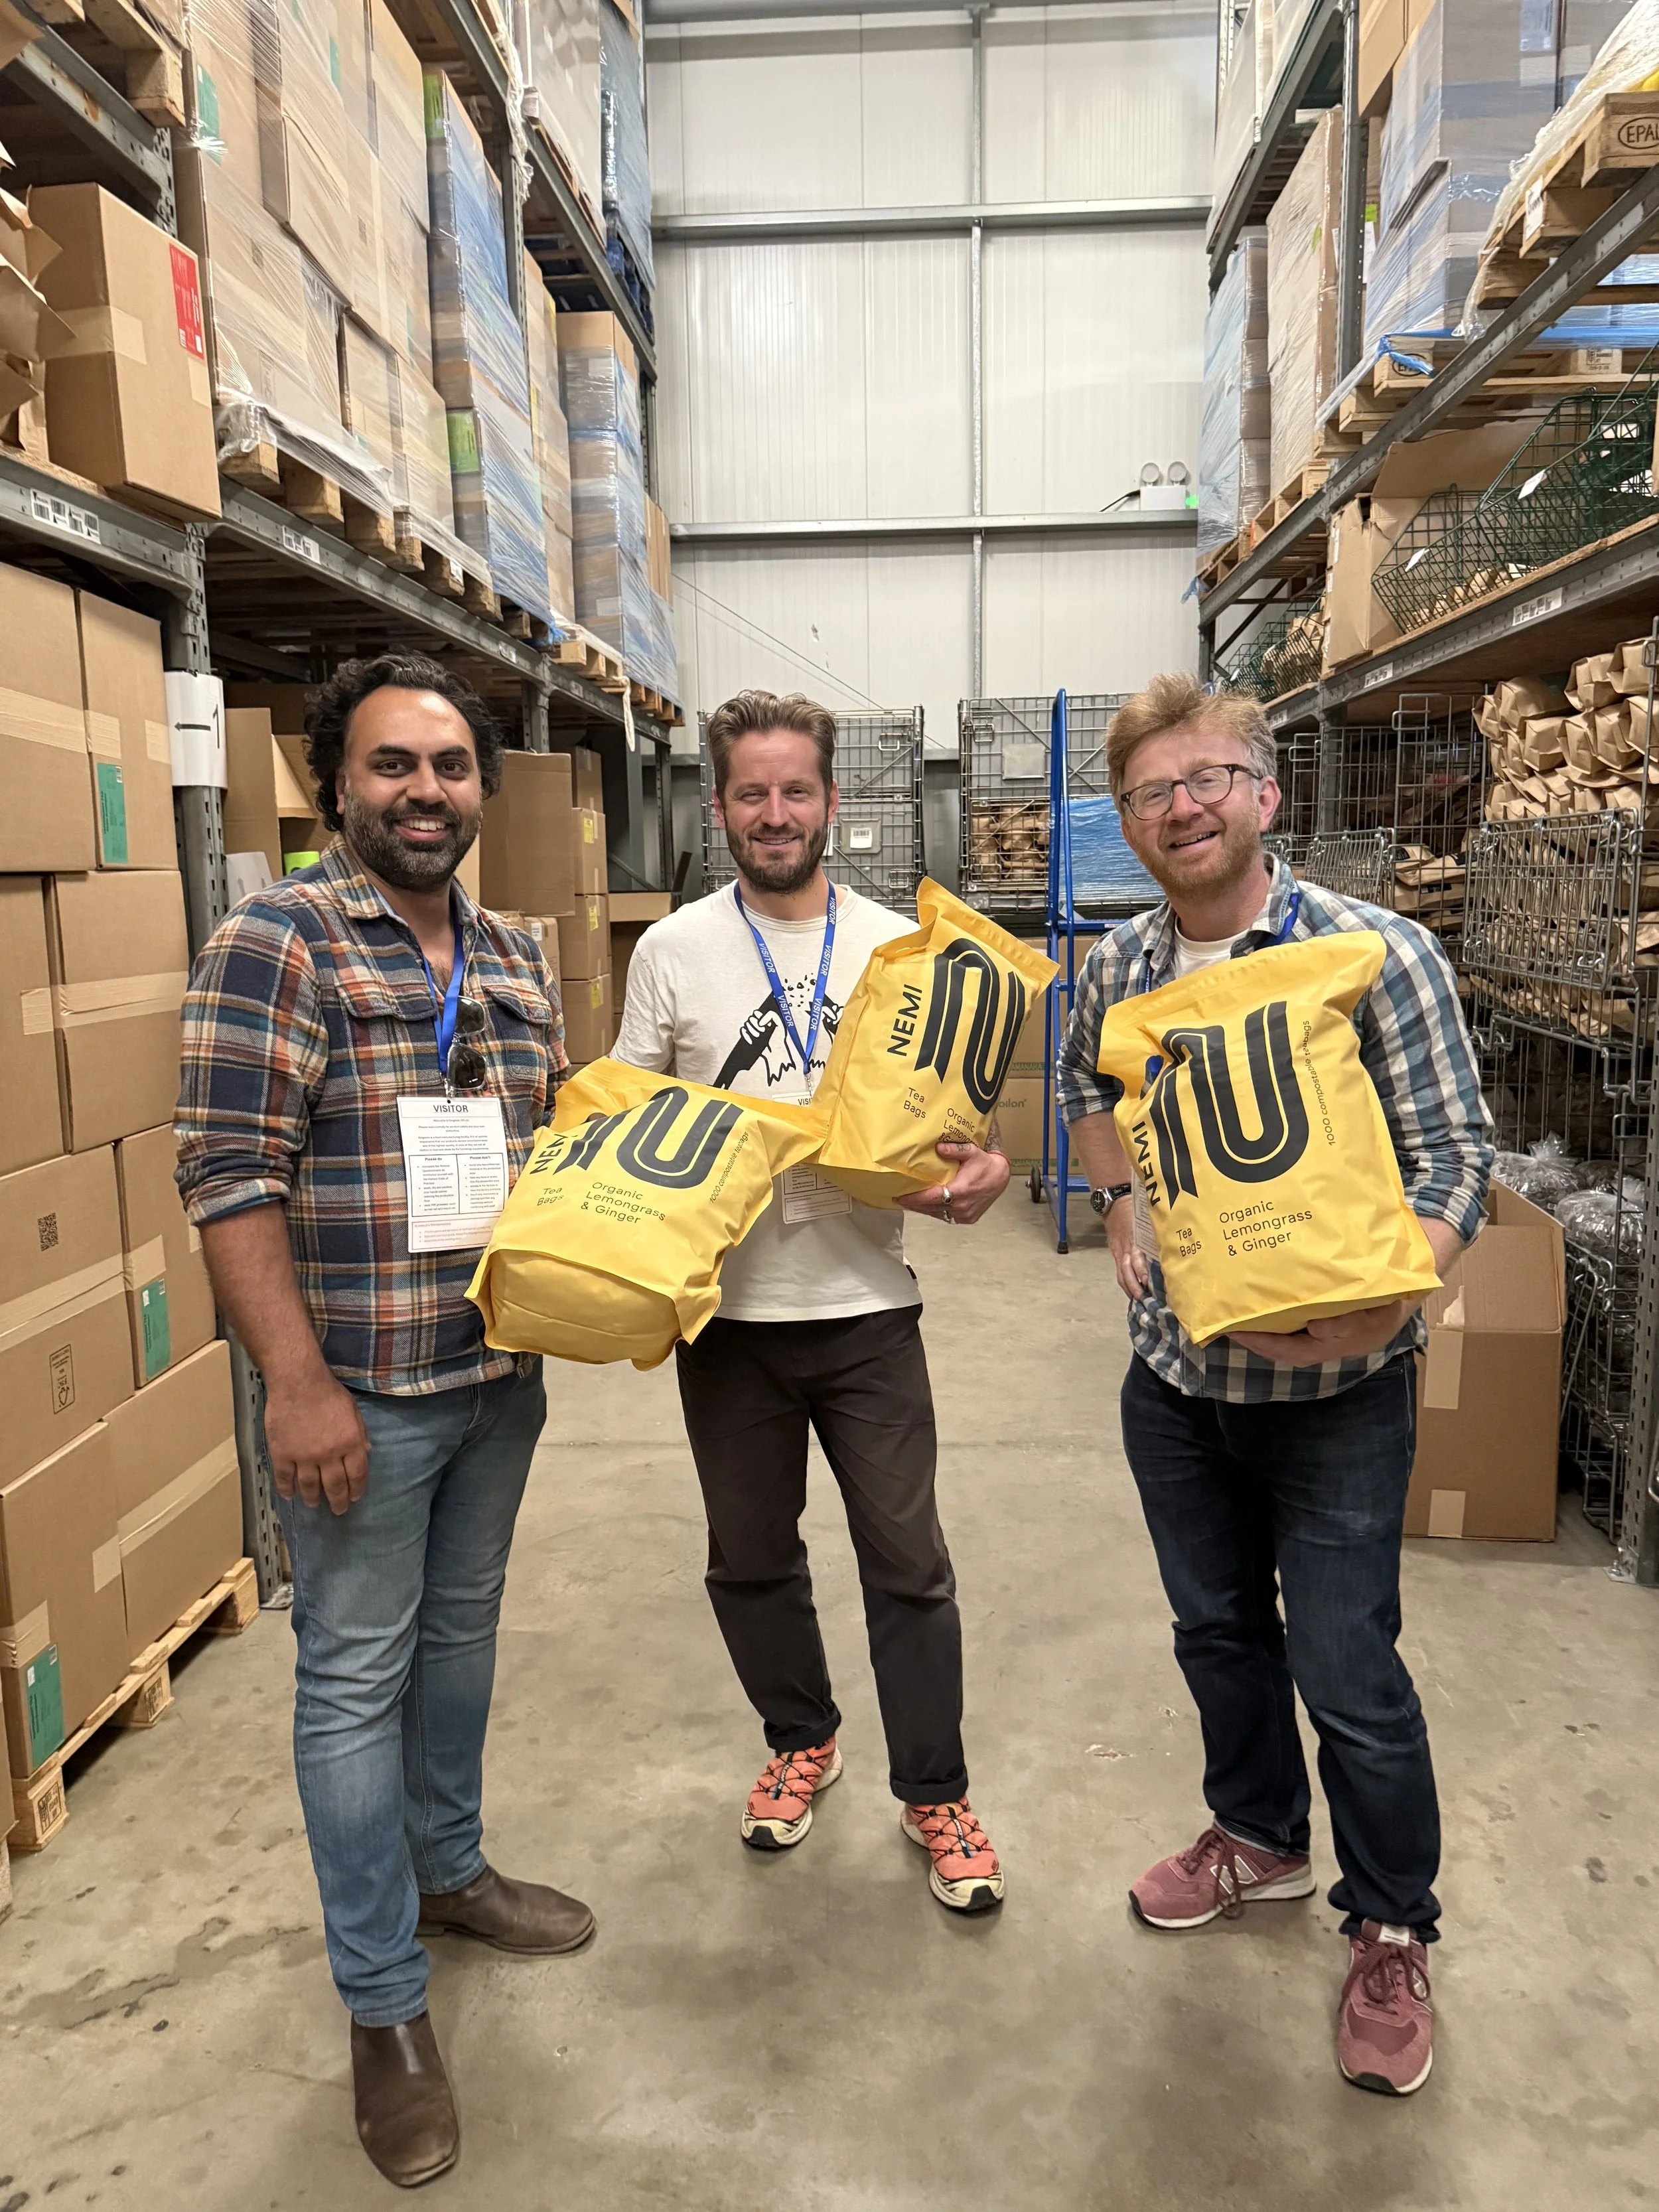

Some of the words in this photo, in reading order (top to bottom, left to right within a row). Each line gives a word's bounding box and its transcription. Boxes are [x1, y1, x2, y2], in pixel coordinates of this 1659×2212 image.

[212, 703, 220, 749] 1
[759, 942, 775, 973] VISITOR
[820, 944, 831, 976] VISITOR
[778, 995, 794, 1027] VISITOR
[810, 997, 822, 1031] VISITOR
[887, 984, 922, 1057] NEMI
[908, 1087, 925, 1103] Tea
[1305, 1059, 1328, 1116] compostable
[433, 1104, 469, 1113] VISITOR
[903, 1100, 926, 1119] Bags
[947, 1108, 975, 1133] Organic
[1323, 1118, 1336, 1146] 1000
[1132, 1120, 1161, 1207] NEMI
[543, 1187, 563, 1195] Tea
[592, 1182, 643, 1200] Organic
[710, 1185, 721, 1204] 1000
[719, 1153, 737, 1187] compostable
[536, 1195, 564, 1207] Bags
[581, 1201, 589, 1211] &
[595, 1205, 641, 1224] Ginger
[586, 1191, 666, 1221] Lemongrass
[1219, 1201, 1274, 1224] Organic
[1176, 1226, 1192, 1241] Tea
[1223, 1211, 1313, 1240] Lemongrass
[1179, 1240, 1202, 1258] Bags
[1228, 1244, 1238, 1256] &
[1242, 1232, 1291, 1252] Ginger
